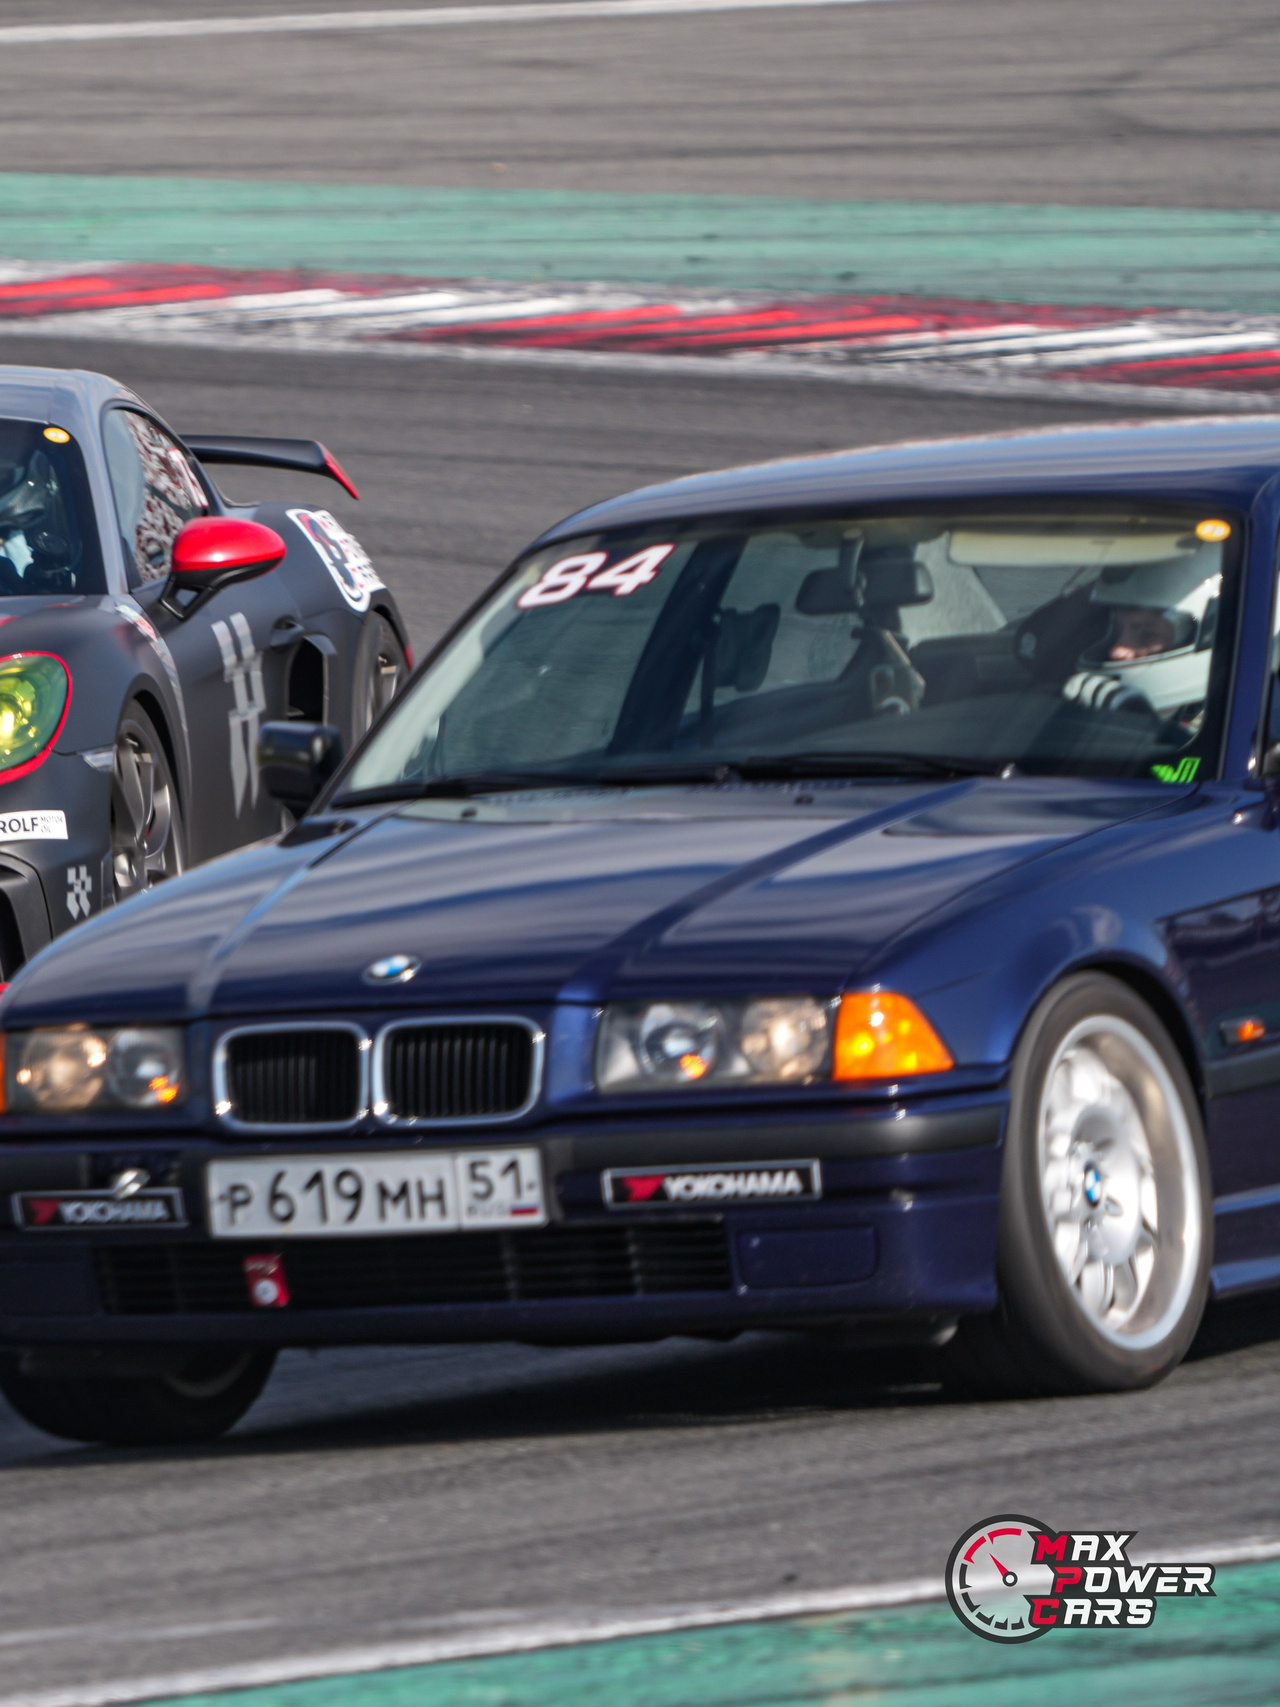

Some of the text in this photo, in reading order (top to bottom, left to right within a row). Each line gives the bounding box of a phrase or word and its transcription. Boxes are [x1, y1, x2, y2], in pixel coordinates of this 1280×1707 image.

[516, 544, 677, 609] 84
[467, 1157, 523, 1201] 51
[663, 1169, 803, 1202] YOKOHAMA
[59, 1200, 170, 1225] YOKOHAMA
